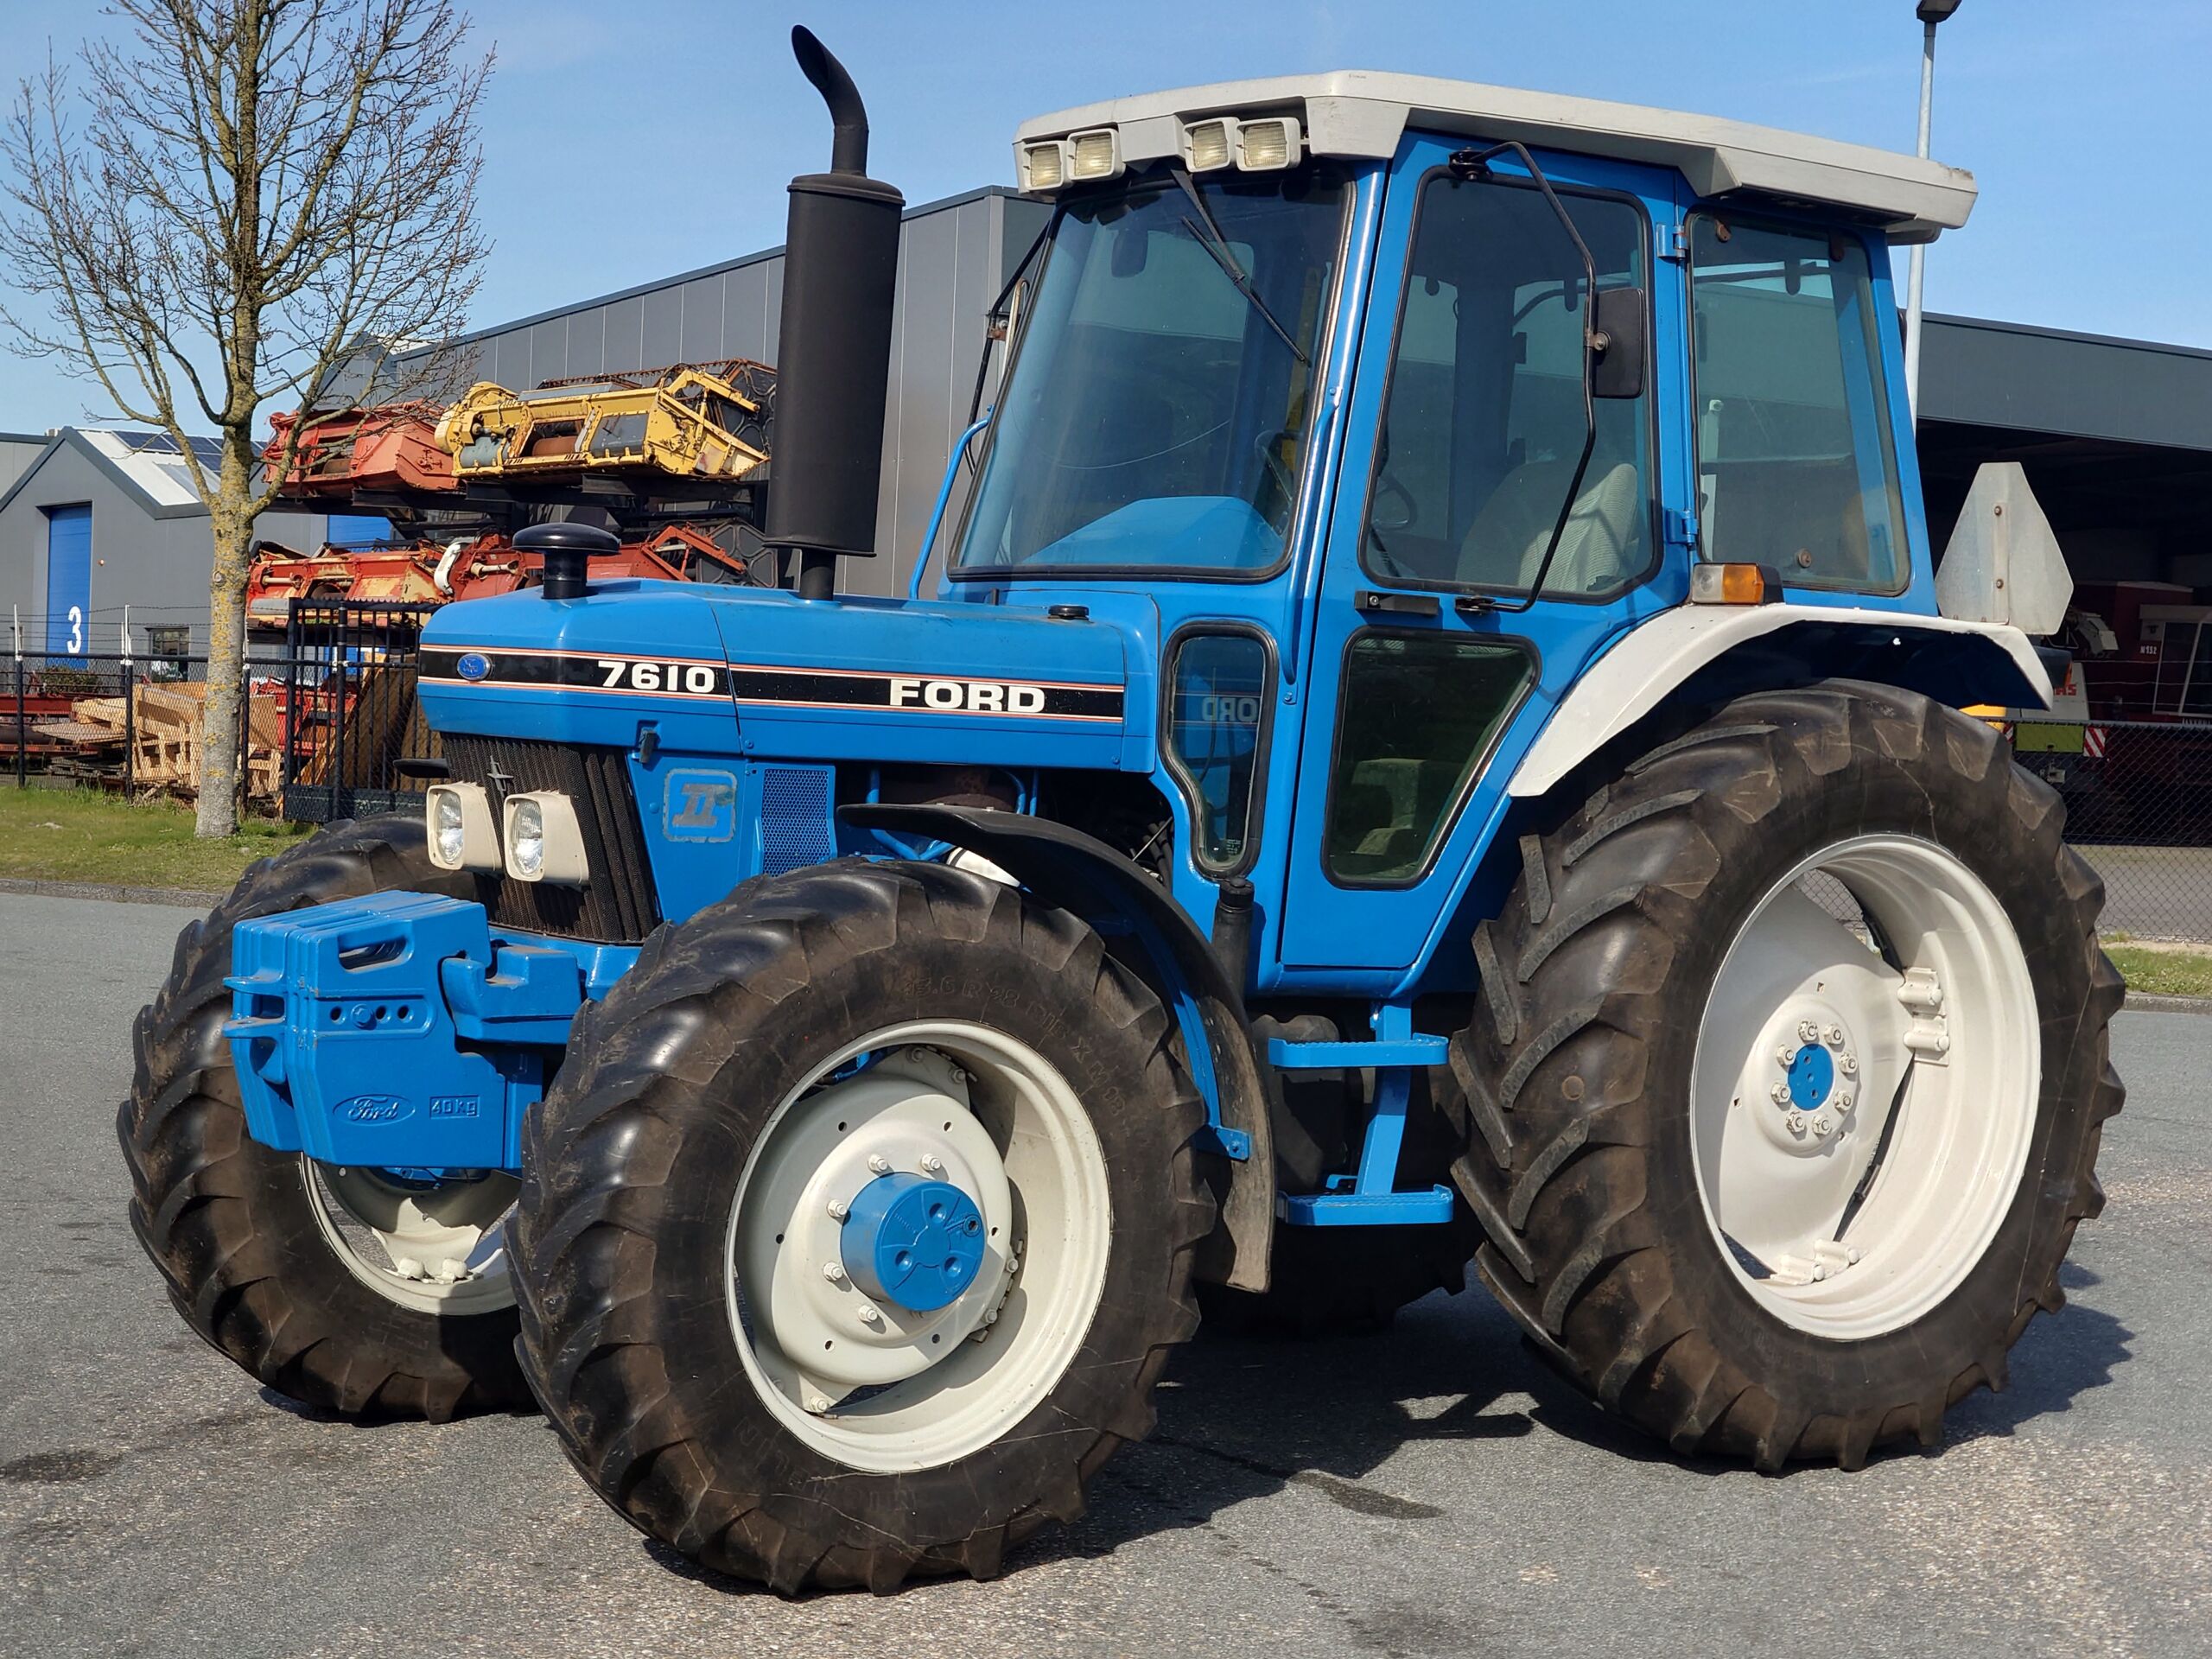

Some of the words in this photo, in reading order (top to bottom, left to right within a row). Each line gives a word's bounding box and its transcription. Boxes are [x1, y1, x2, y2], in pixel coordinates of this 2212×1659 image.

[67, 606, 82, 654] 3
[597, 660, 715, 694] 7610
[889, 678, 1046, 714] FORD
[347, 1096, 399, 1122] Ford
